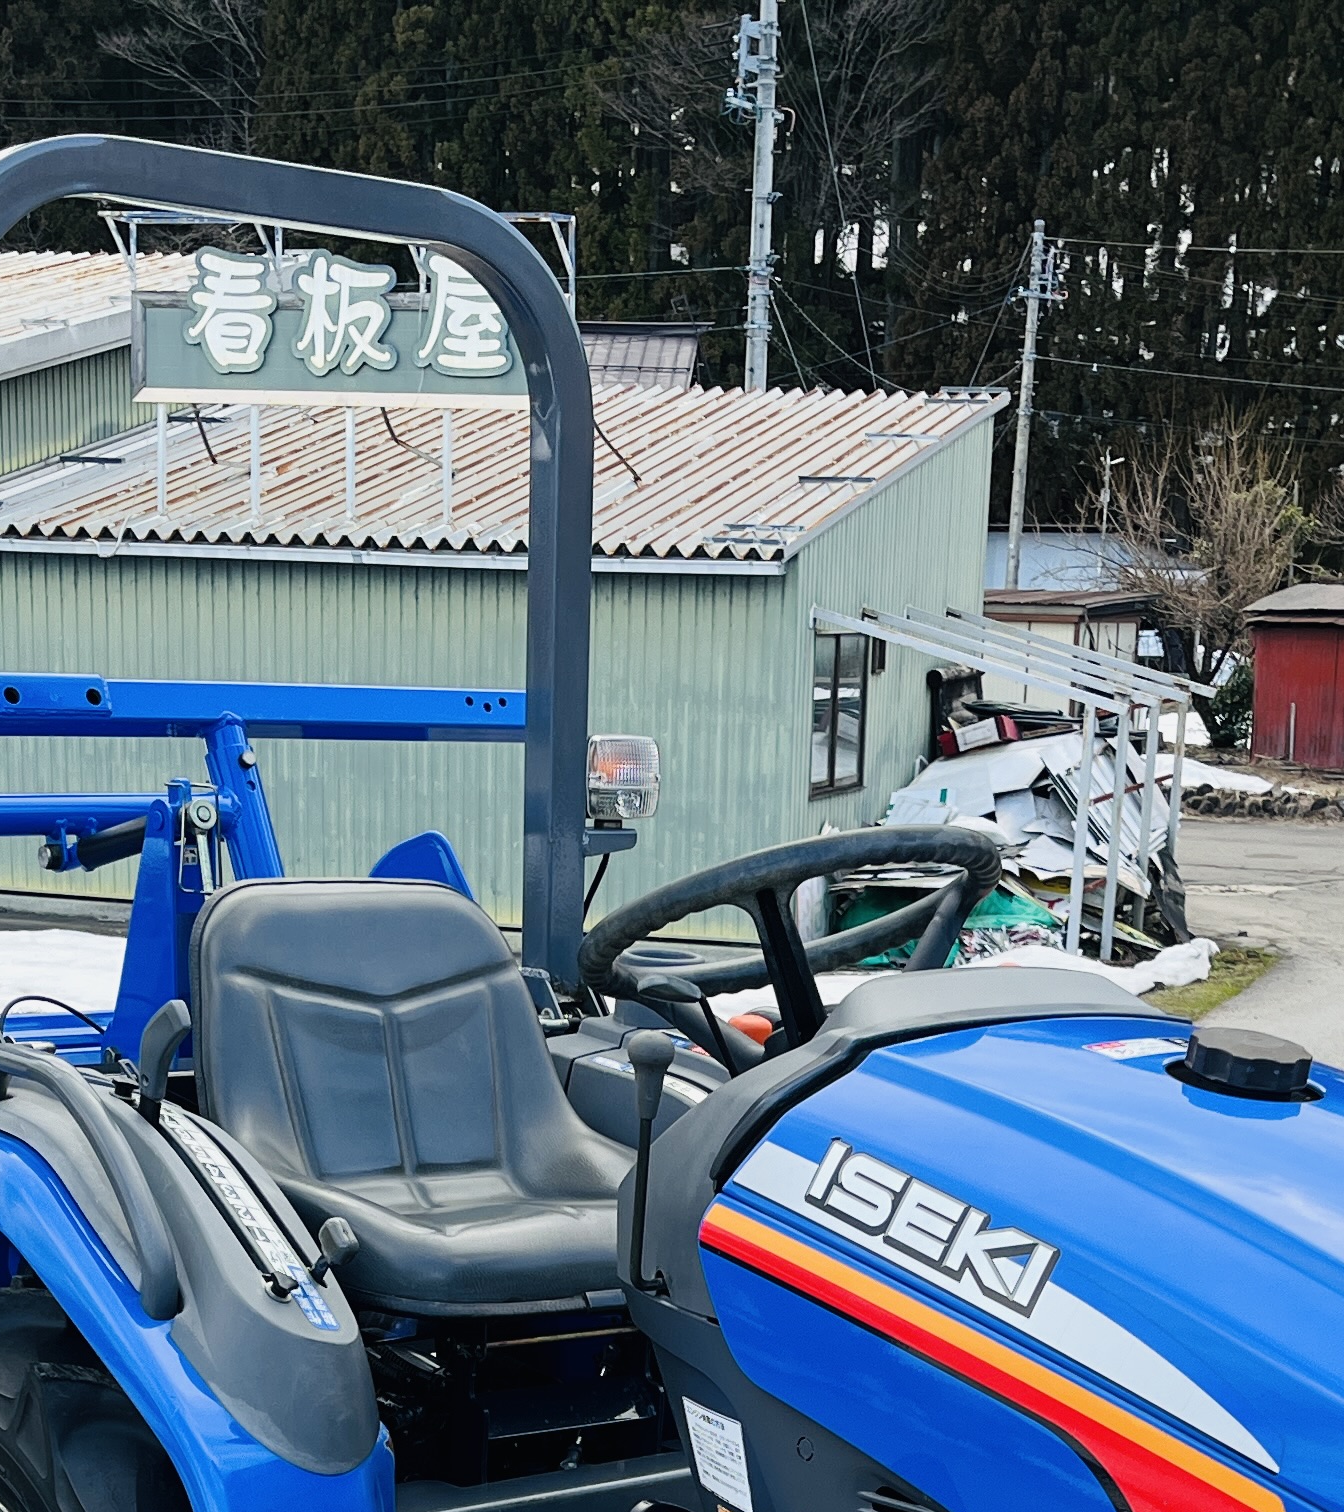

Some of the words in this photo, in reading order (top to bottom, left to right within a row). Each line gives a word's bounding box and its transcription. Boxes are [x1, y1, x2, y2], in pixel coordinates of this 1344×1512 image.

[188, 249, 507, 371] 看板屋
[804, 1137, 1060, 1318] ISEKI
